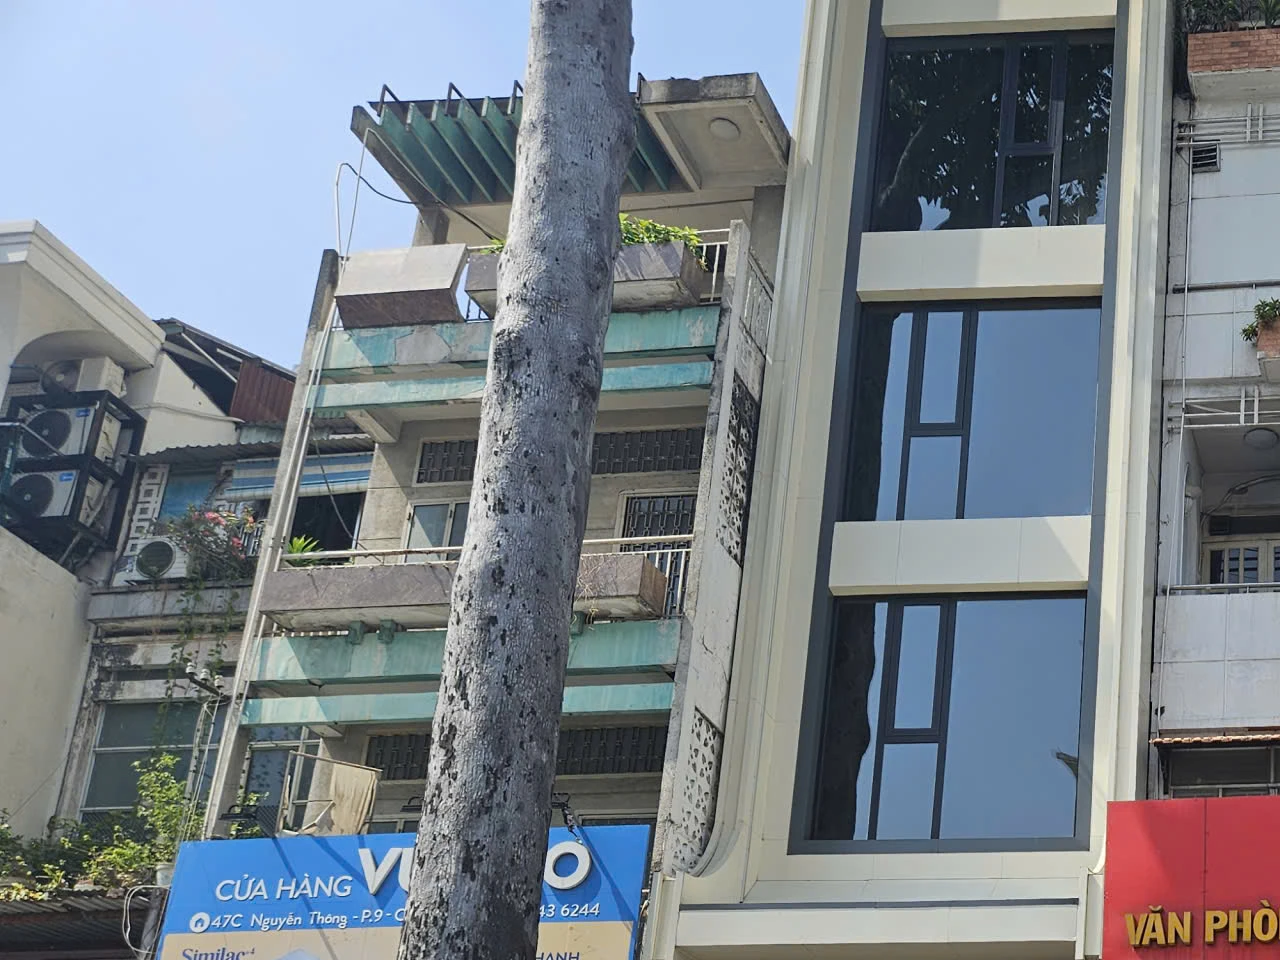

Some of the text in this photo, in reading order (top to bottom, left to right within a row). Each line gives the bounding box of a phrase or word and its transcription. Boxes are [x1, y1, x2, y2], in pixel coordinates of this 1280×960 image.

[215, 874, 268, 901] CỬA
[276, 873, 353, 899] HÀNG
[211, 913, 244, 928] 47C
[250, 912, 301, 931] Nguyễn
[309, 911, 348, 929] Thông
[560, 903, 600, 917] 6244
[1124, 905, 1191, 949] VĂN
